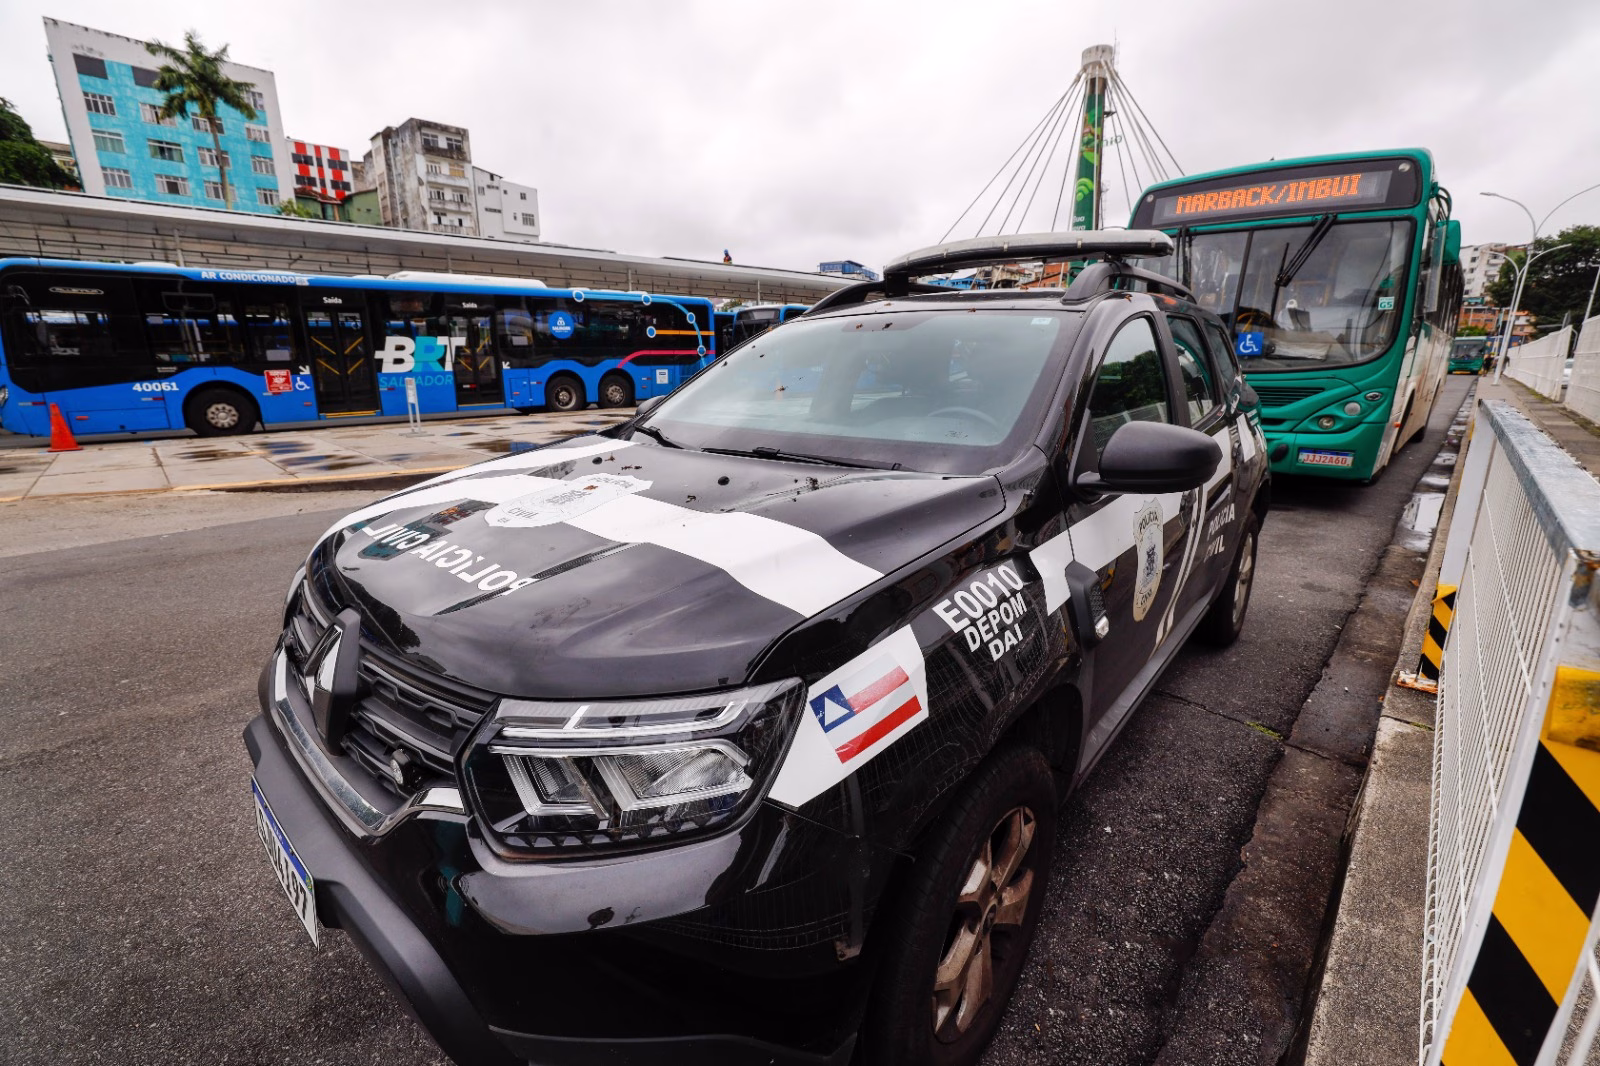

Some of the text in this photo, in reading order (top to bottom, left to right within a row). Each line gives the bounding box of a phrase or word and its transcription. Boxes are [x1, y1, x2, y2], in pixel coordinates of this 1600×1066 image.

[1175, 173, 1362, 215] MARBACK/IMBUI
[201, 271, 297, 284] AR CONDICIONADO
[374, 335, 467, 374] BRT
[132, 381, 180, 393] 40061
[379, 374, 453, 388] SALADOR
[931, 564, 1024, 634] E0010
[963, 591, 1028, 653] DEPOM
[988, 623, 1024, 662] DAI
